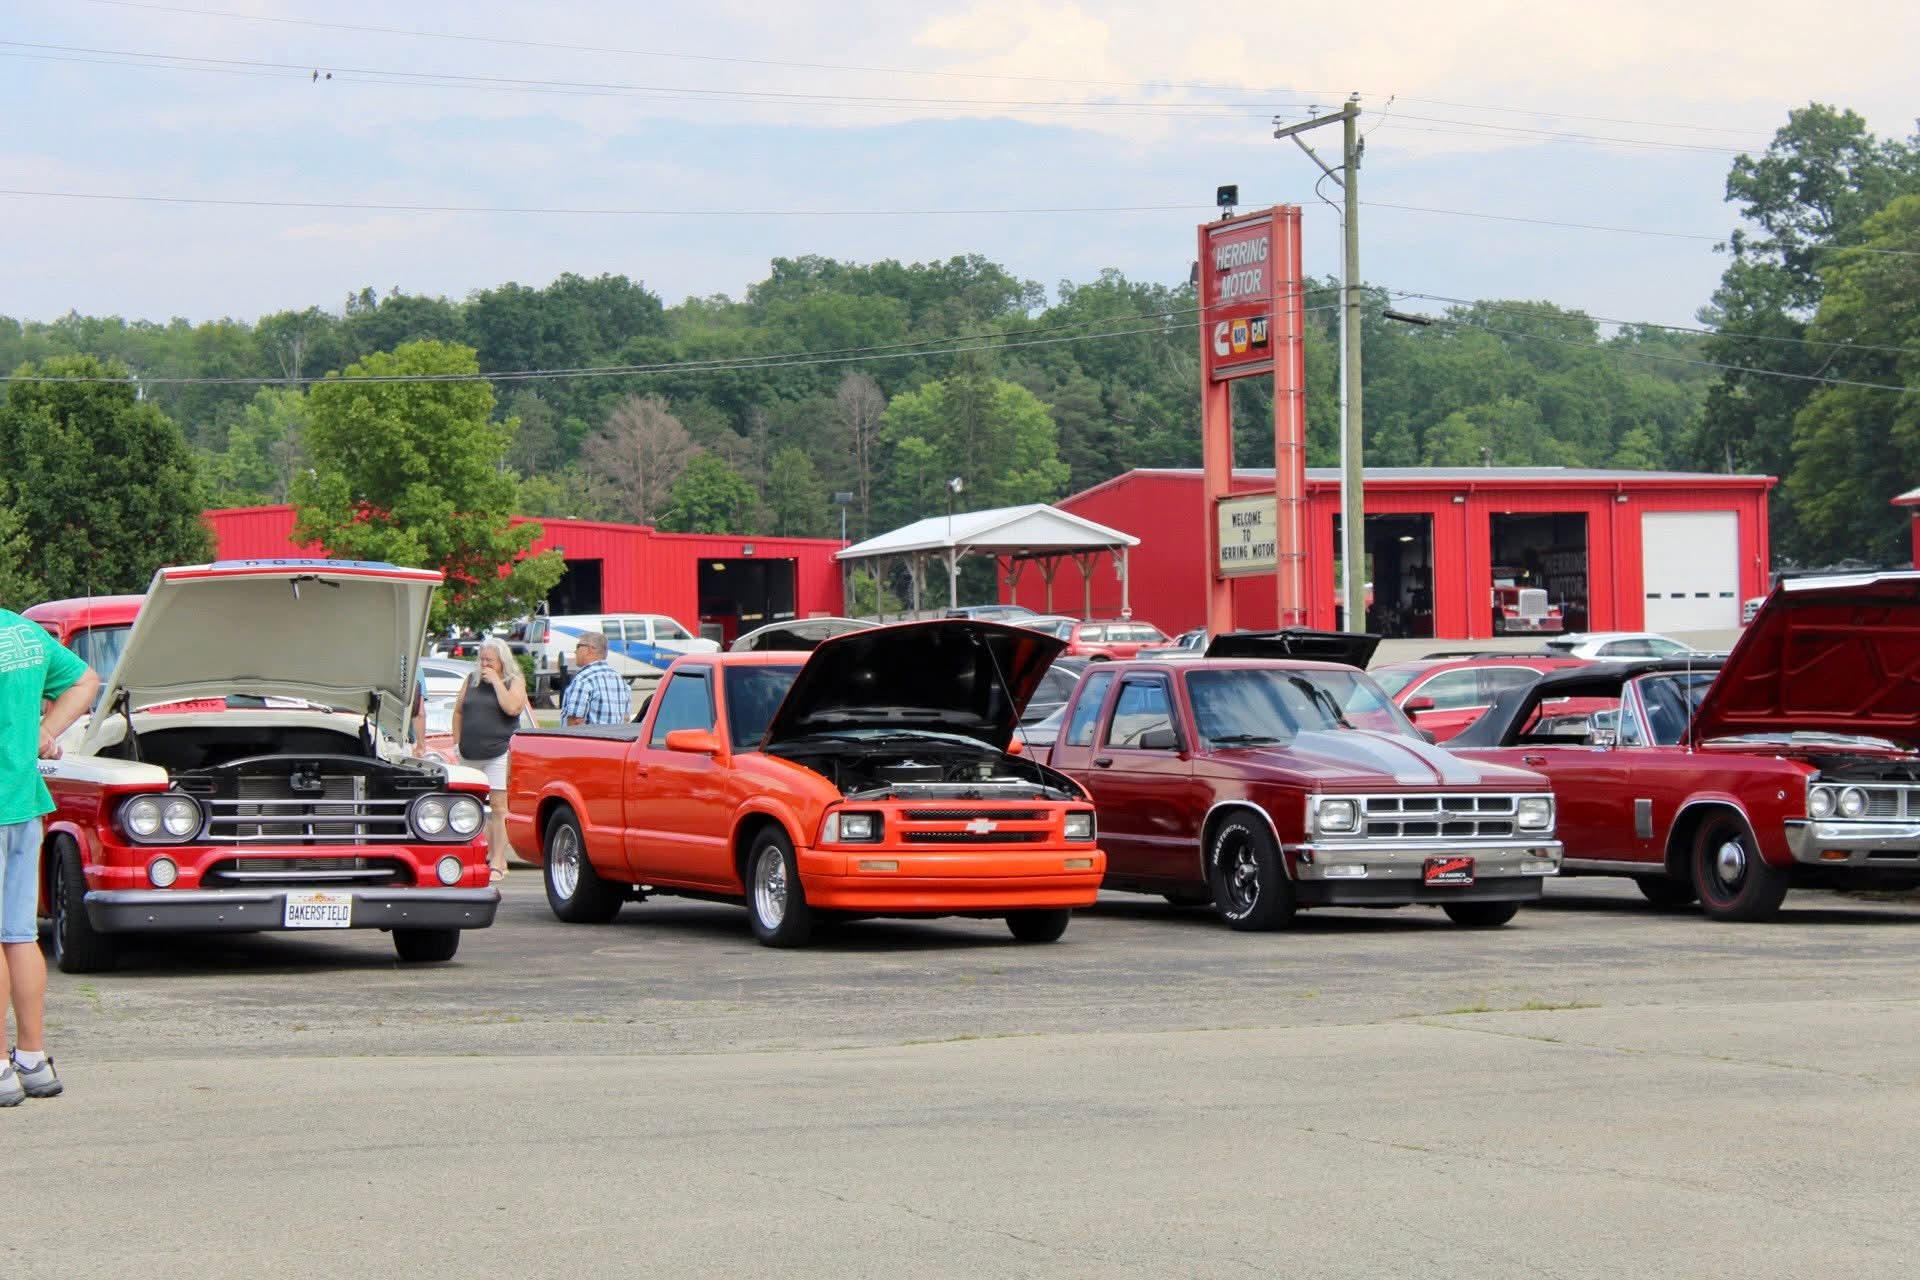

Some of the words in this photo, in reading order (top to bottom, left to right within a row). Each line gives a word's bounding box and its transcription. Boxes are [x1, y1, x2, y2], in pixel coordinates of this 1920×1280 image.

[1216, 236, 1268, 270] HERRING
[1221, 268, 1262, 298] MOTOR
[1251, 320, 1268, 343] CAT
[1232, 510, 1262, 528] WELCOME
[1243, 528, 1251, 542] TO
[1222, 545, 1248, 560] HERRING
[1252, 543, 1275, 559] MOTOR
[289, 905, 349, 921] BAKERSFIELD
